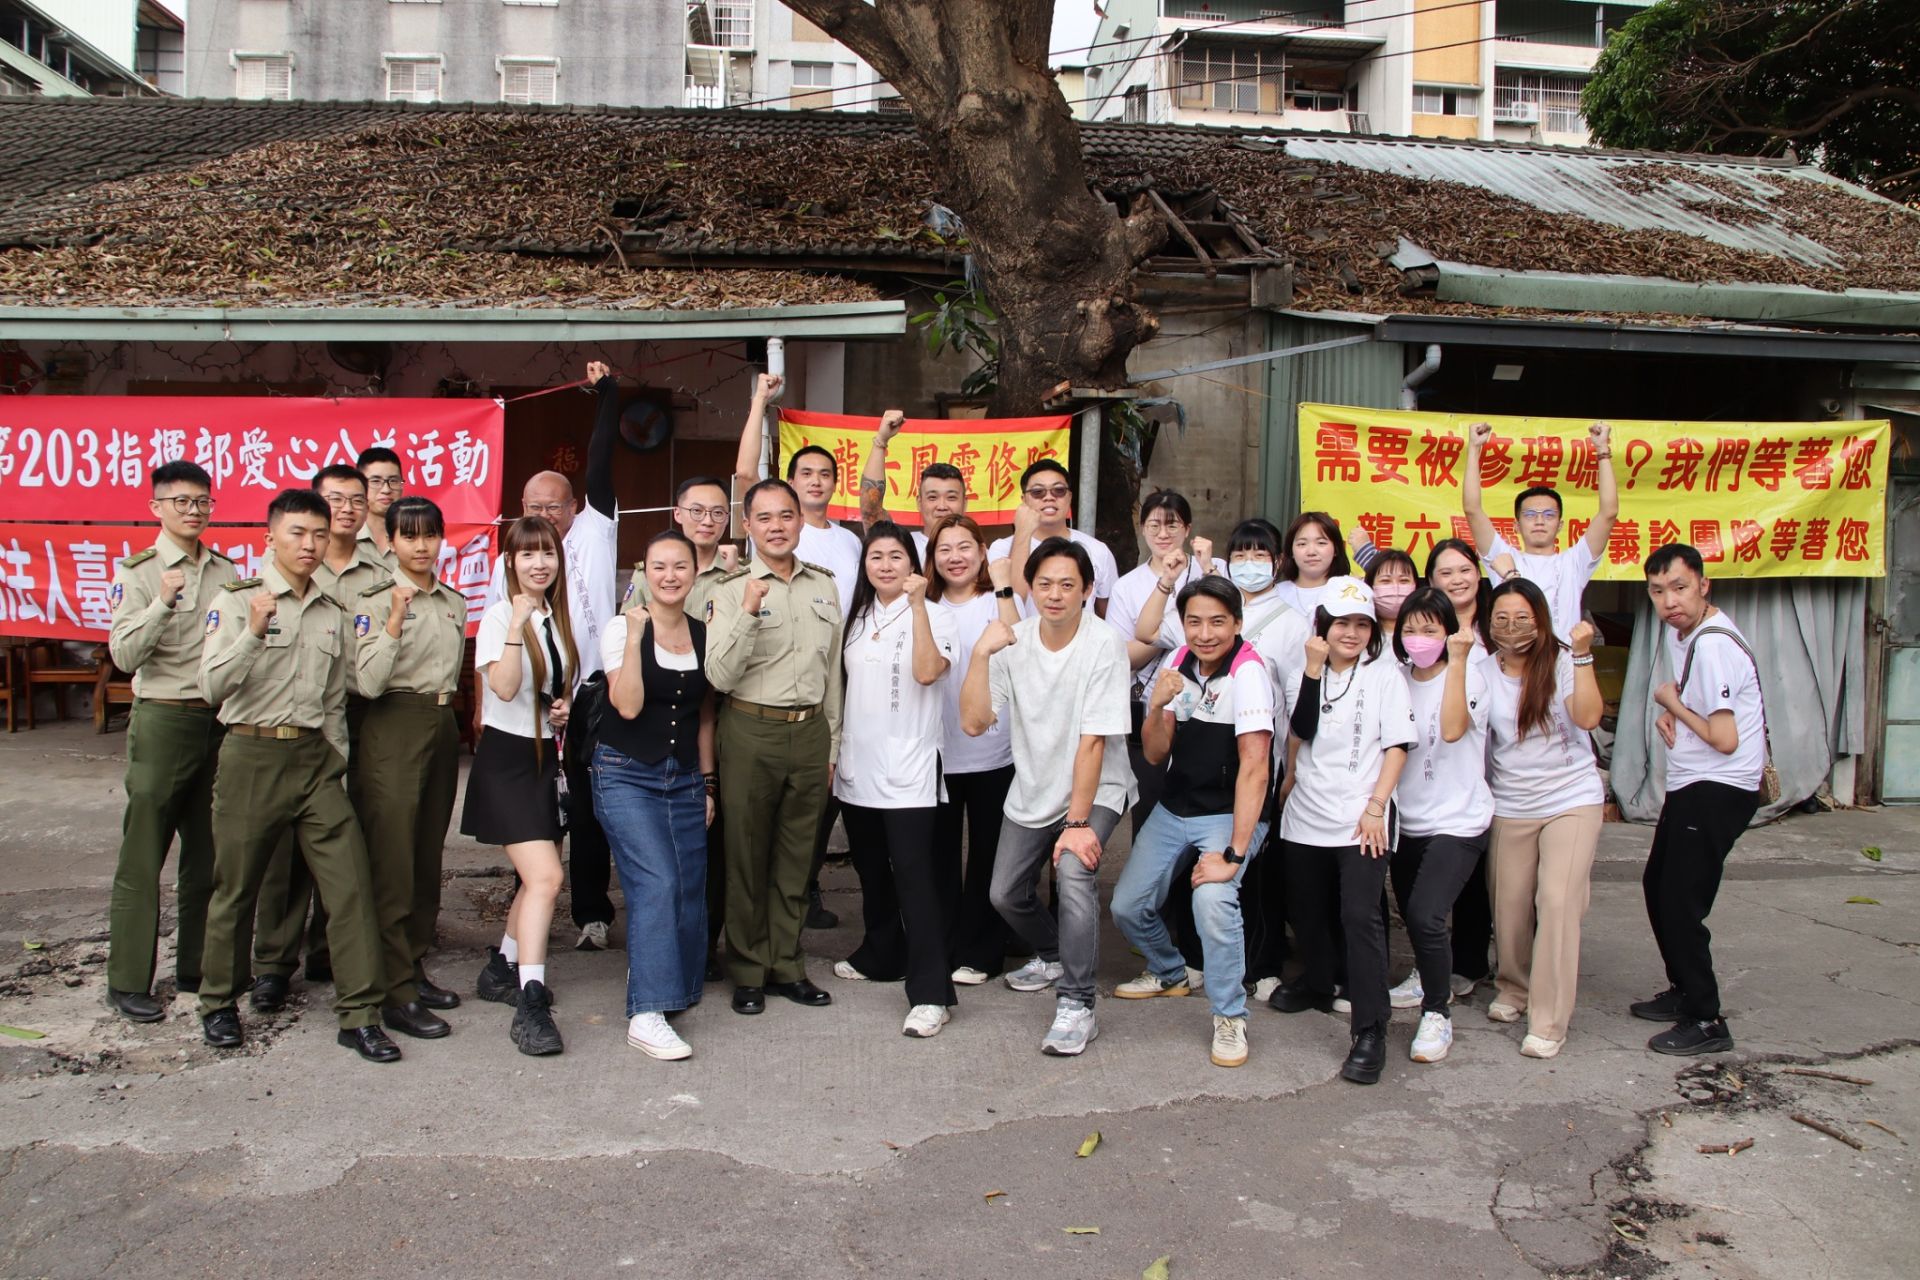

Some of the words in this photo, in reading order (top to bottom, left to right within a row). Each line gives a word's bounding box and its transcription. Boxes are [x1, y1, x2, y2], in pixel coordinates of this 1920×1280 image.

[0, 427, 489, 490] 203指揮部愛心公活動
[801, 436, 1059, 501] 龍六鳳靈修
